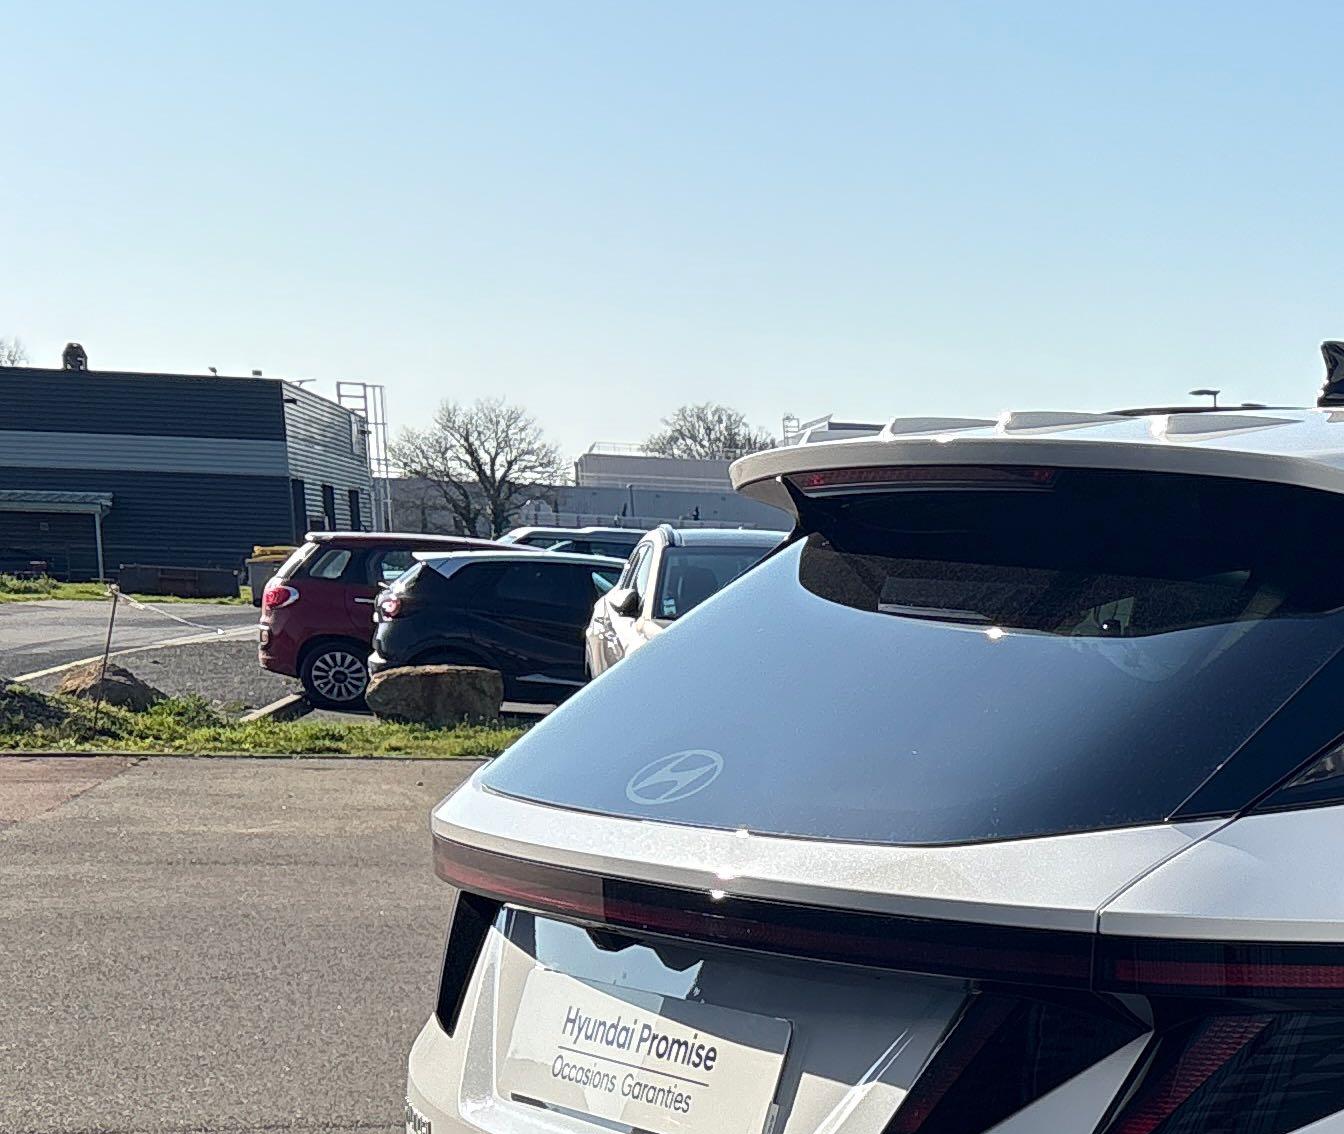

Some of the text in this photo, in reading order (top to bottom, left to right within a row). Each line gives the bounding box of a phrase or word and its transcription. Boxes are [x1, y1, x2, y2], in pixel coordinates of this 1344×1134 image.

[561, 1005, 718, 1071] Hyundai Promise
[551, 1054, 692, 1114] Occasions Garanties
